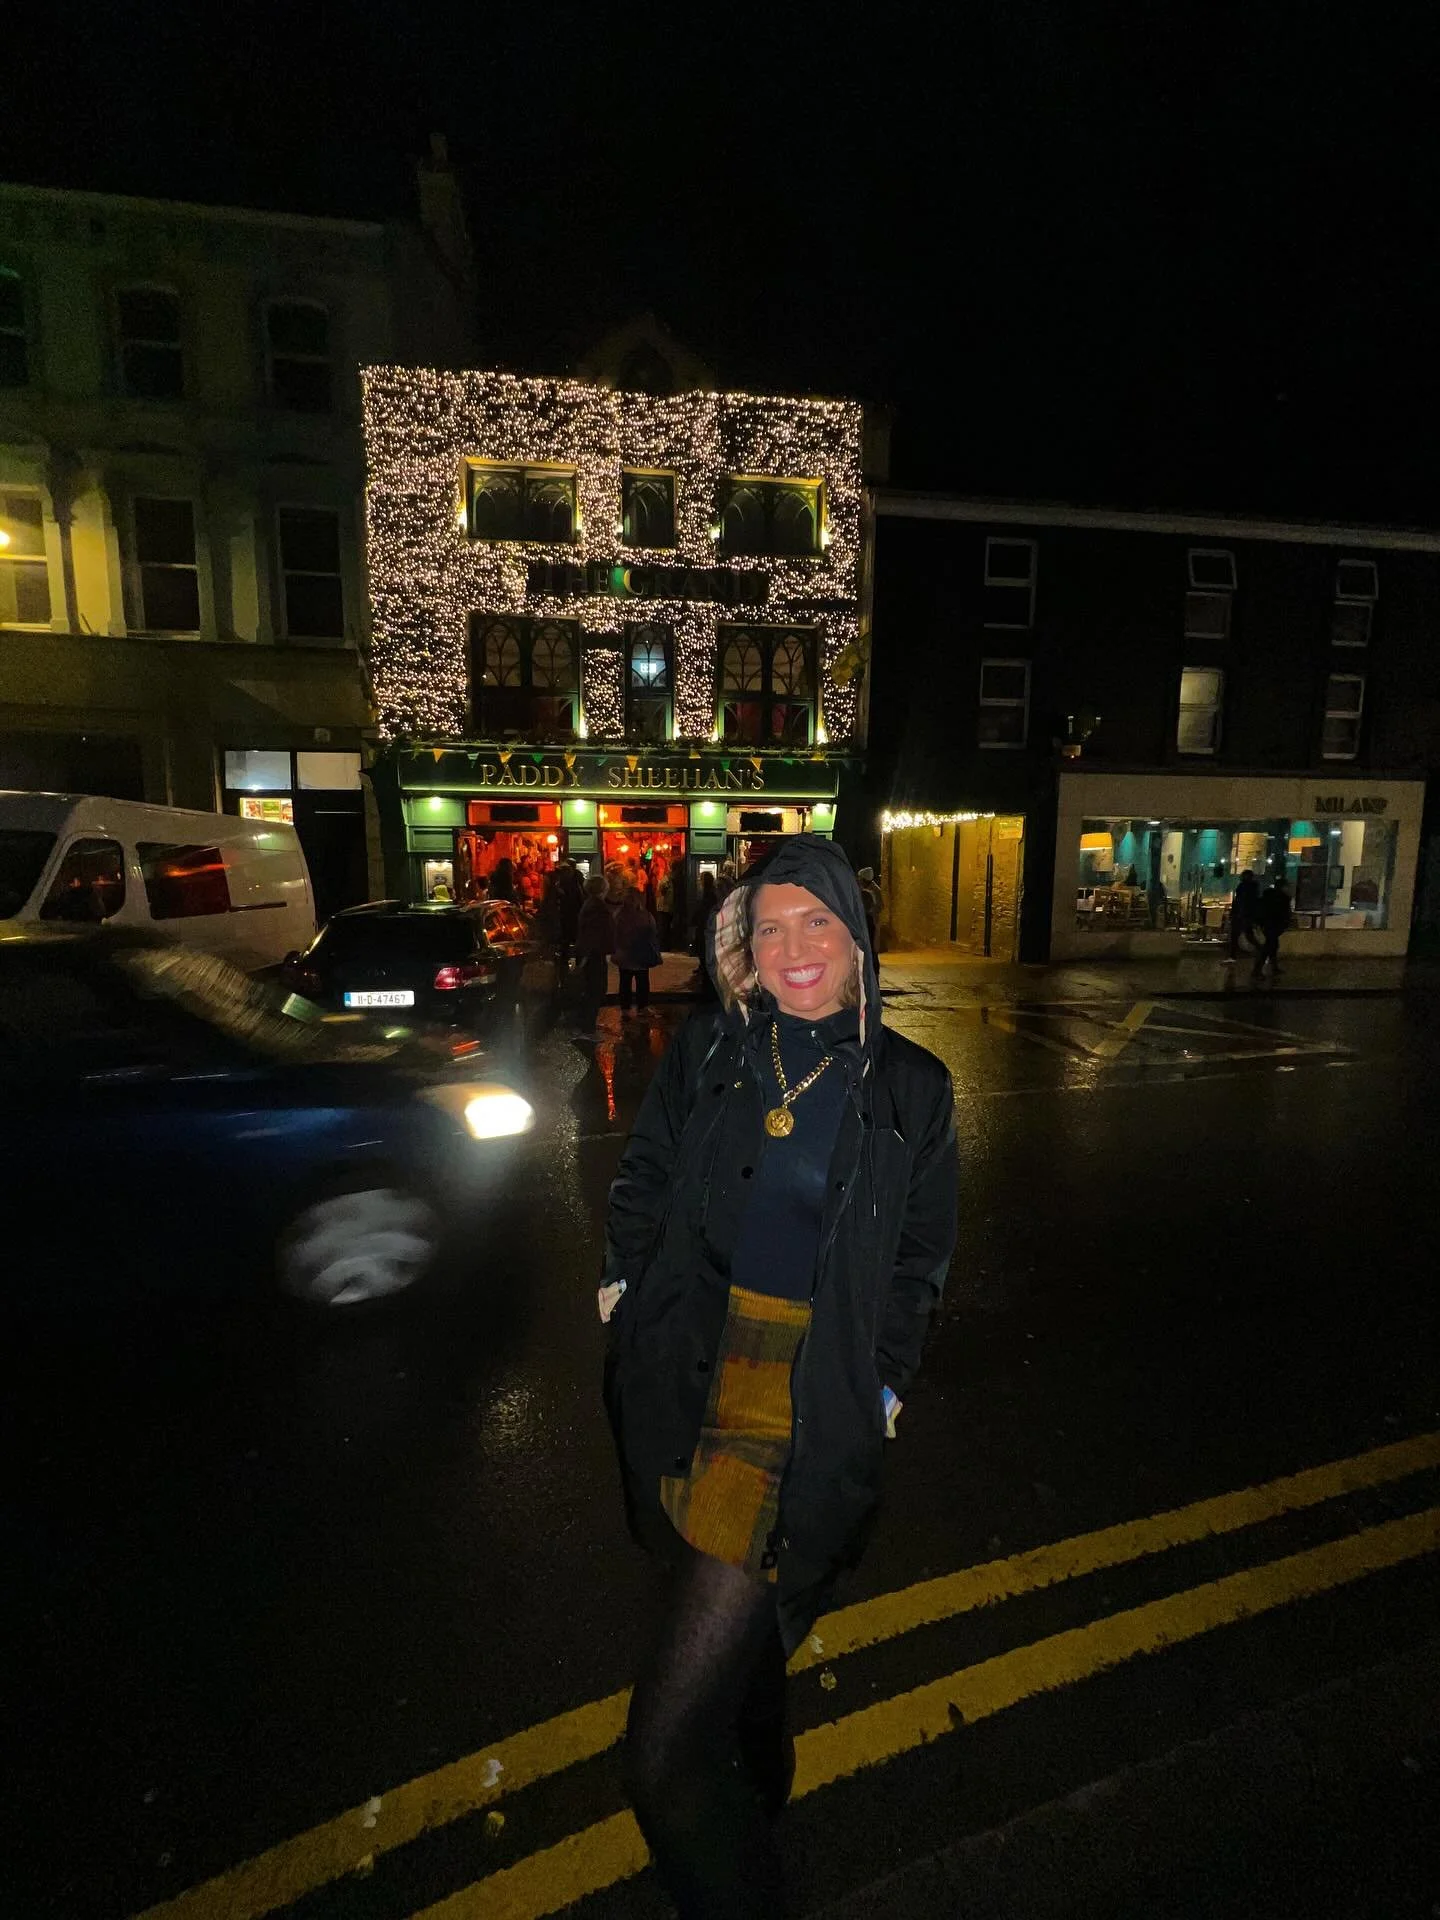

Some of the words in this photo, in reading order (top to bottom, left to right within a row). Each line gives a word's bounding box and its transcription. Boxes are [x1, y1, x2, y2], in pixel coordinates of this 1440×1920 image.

[539, 566, 609, 594] THE
[622, 568, 760, 599] GRAND
[480, 763, 584, 788] PADDY
[608, 766, 766, 790] SHEEHAN'S
[358, 994, 406, 1005] 11-D-47467
